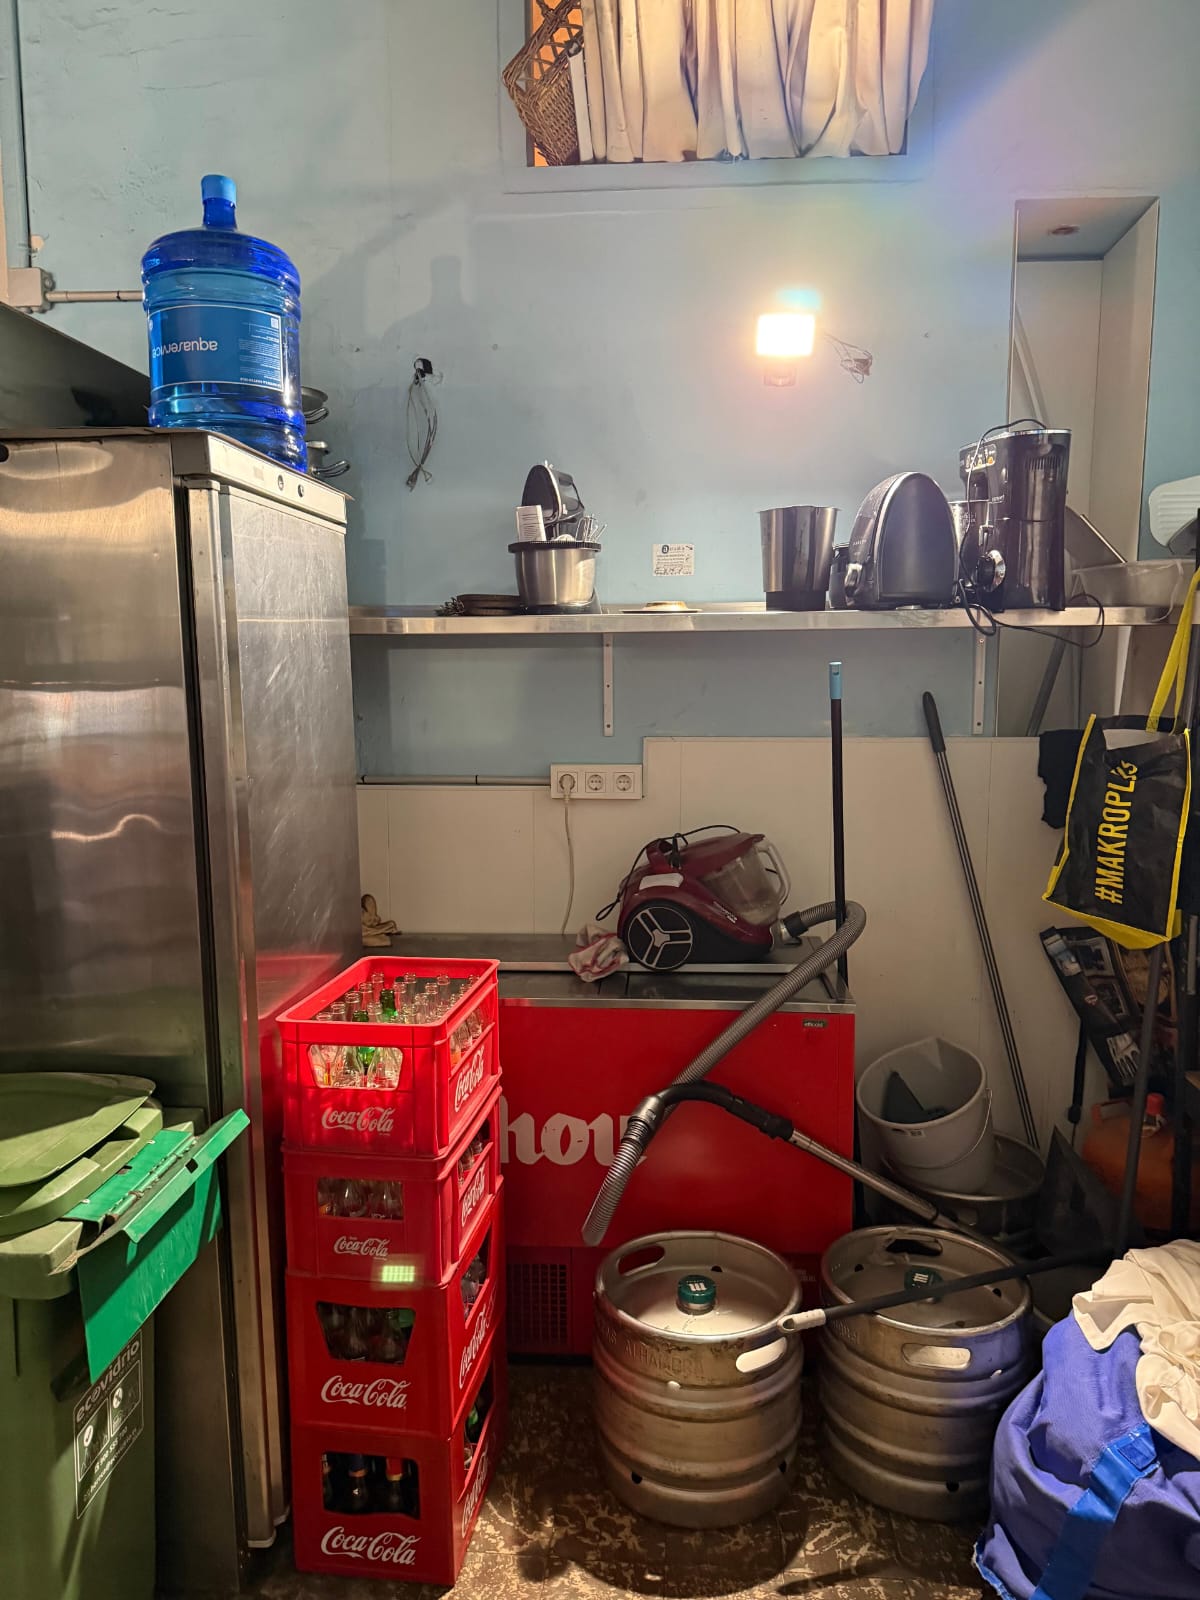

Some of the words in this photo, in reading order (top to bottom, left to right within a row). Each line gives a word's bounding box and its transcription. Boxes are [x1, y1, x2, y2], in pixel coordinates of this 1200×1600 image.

[152, 337, 218, 359] aquaservice
[321, 1106, 396, 1132] Coca-Cola
[333, 1235, 391, 1257] Coca-Cola
[76, 1340, 140, 1422] ecovidrio
[321, 1375, 411, 1408] Coca-Cola
[321, 1527, 421, 1564] Coca-Cola
